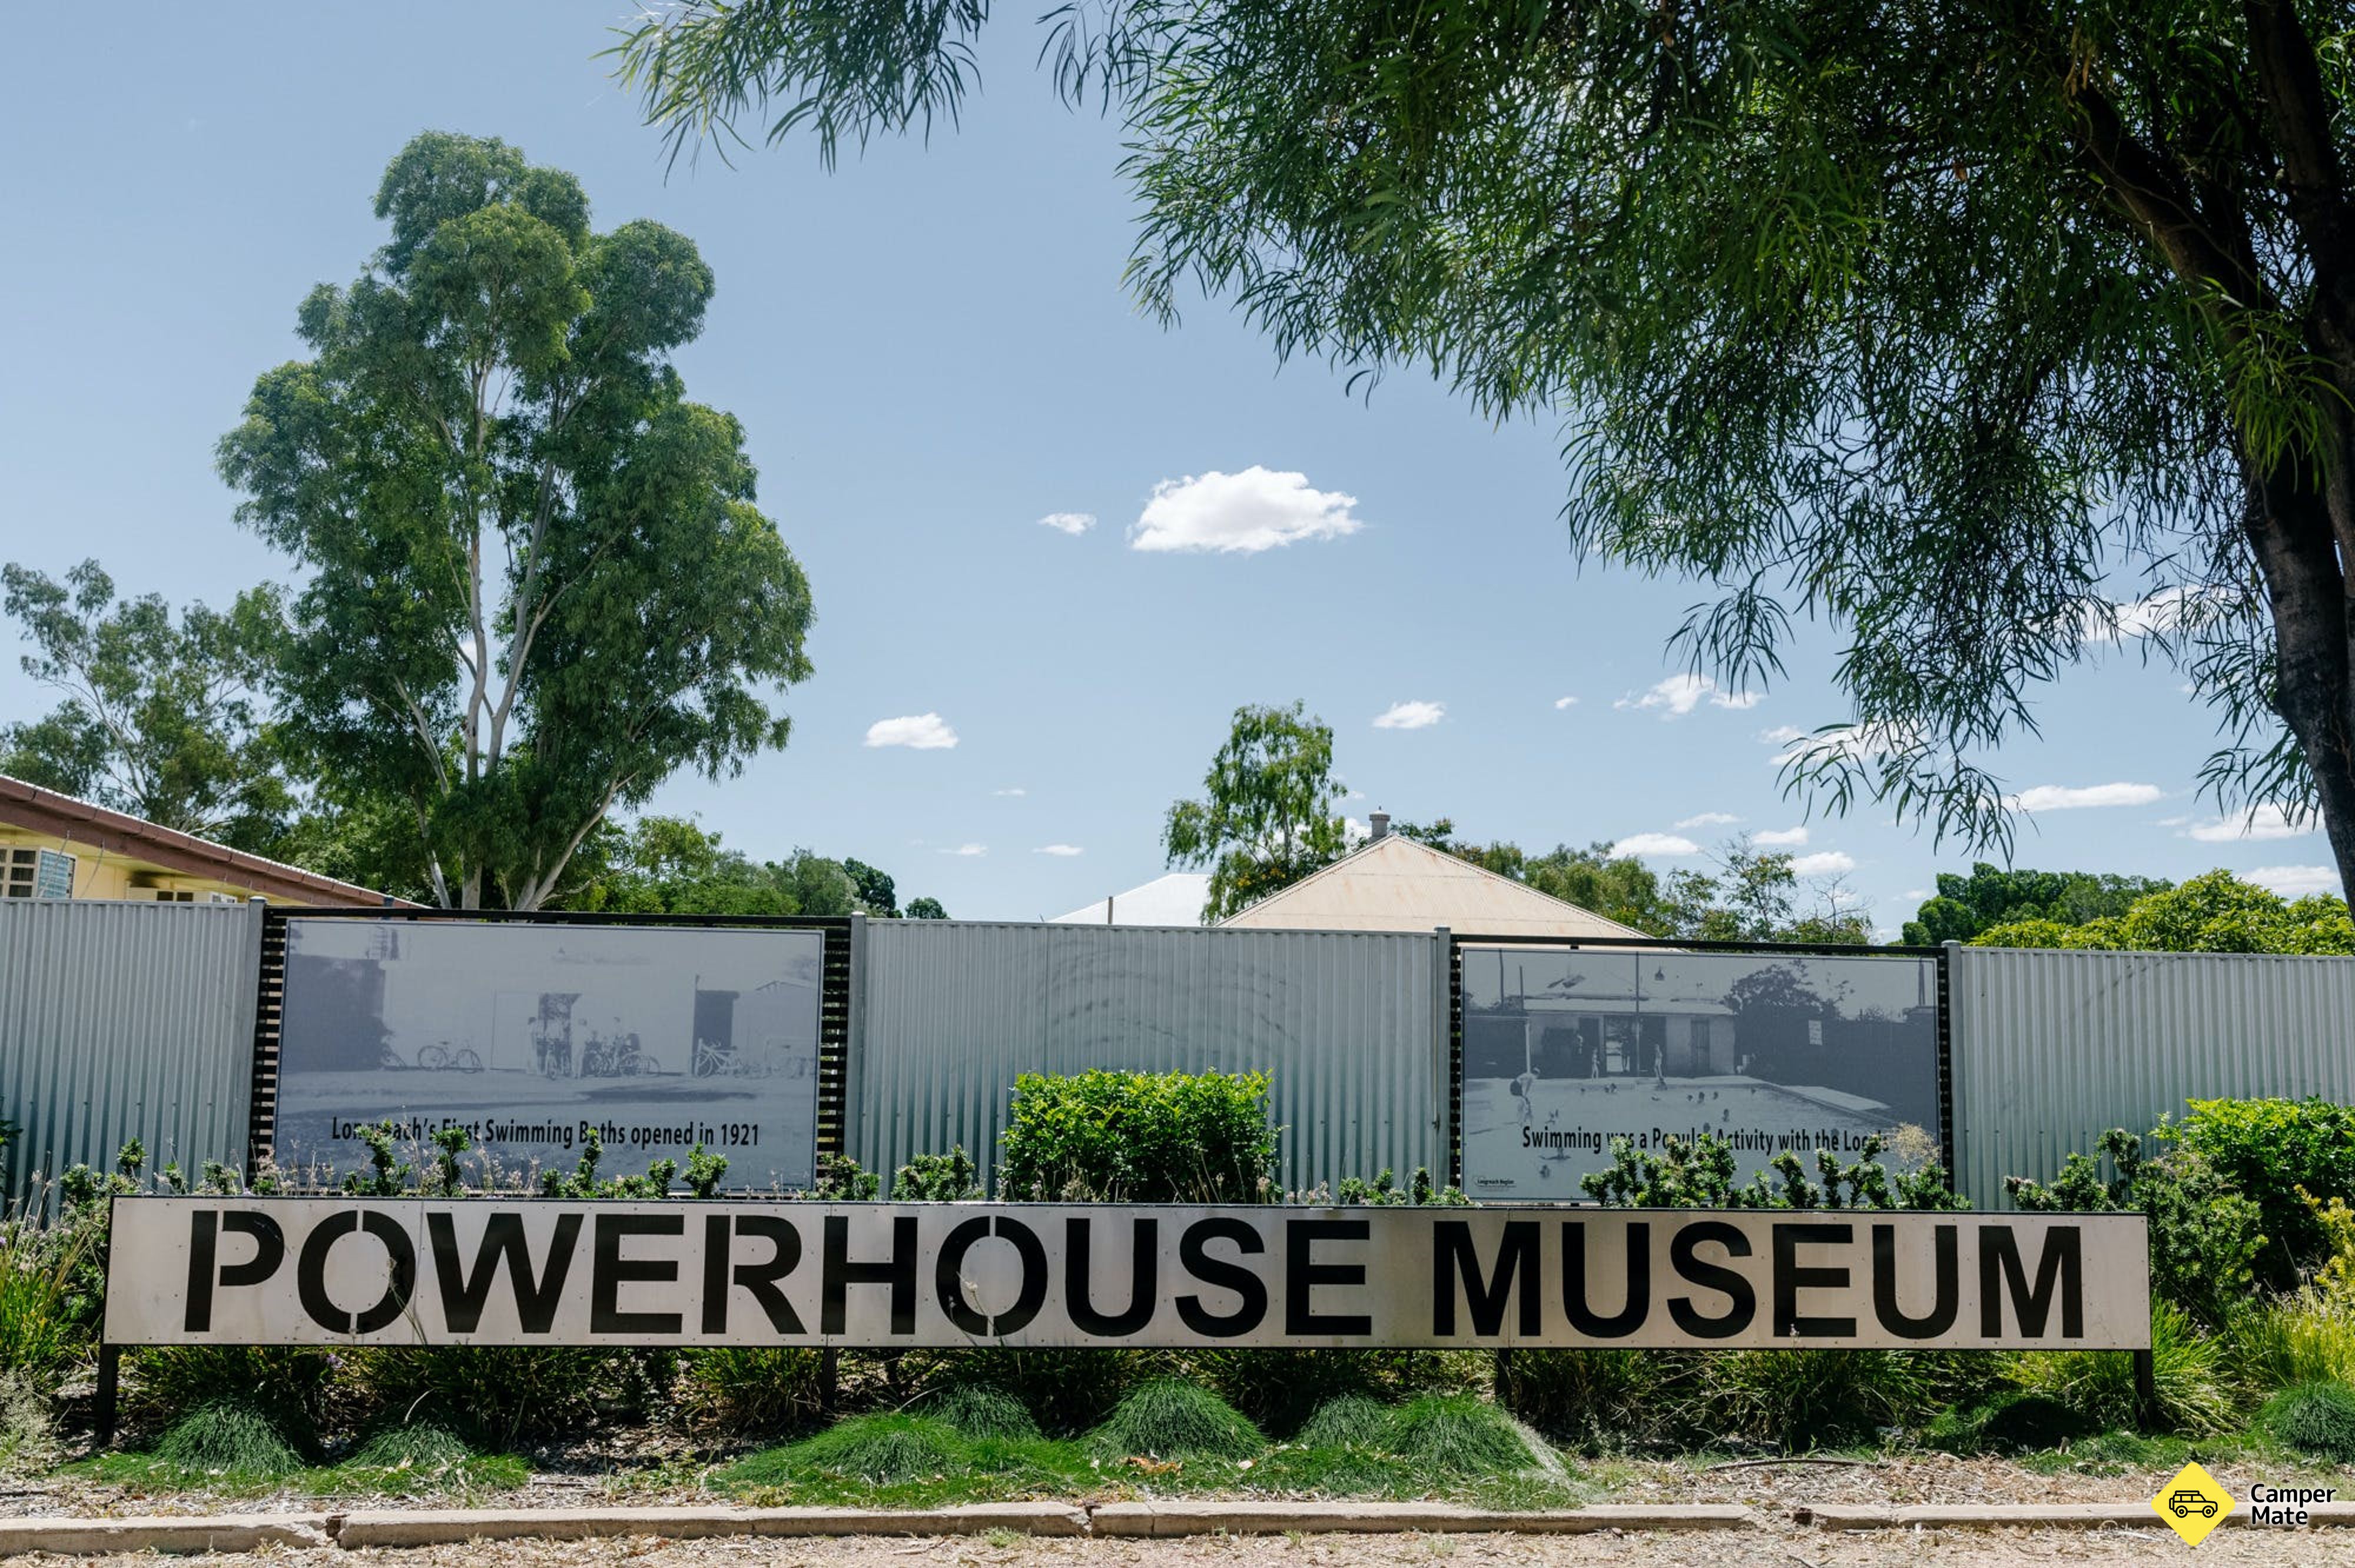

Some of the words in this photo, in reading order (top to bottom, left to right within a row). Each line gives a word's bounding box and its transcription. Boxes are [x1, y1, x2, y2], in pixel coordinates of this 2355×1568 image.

[331, 1117, 436, 1144] Lonach's
[485, 1119, 573, 1149] Swimming
[631, 1121, 694, 1150] opened
[698, 1122, 714, 1145] in
[721, 1124, 758, 1146] 1921
[1523, 1125, 1601, 1154] Swimming
[1640, 1133, 1647, 1148] a
[1779, 1129, 1810, 1151] with
[1816, 1129, 1839, 1151] the
[184, 1210, 1372, 1338] POWERHOUSE
[1434, 1220, 2084, 1339] MUSEUM
